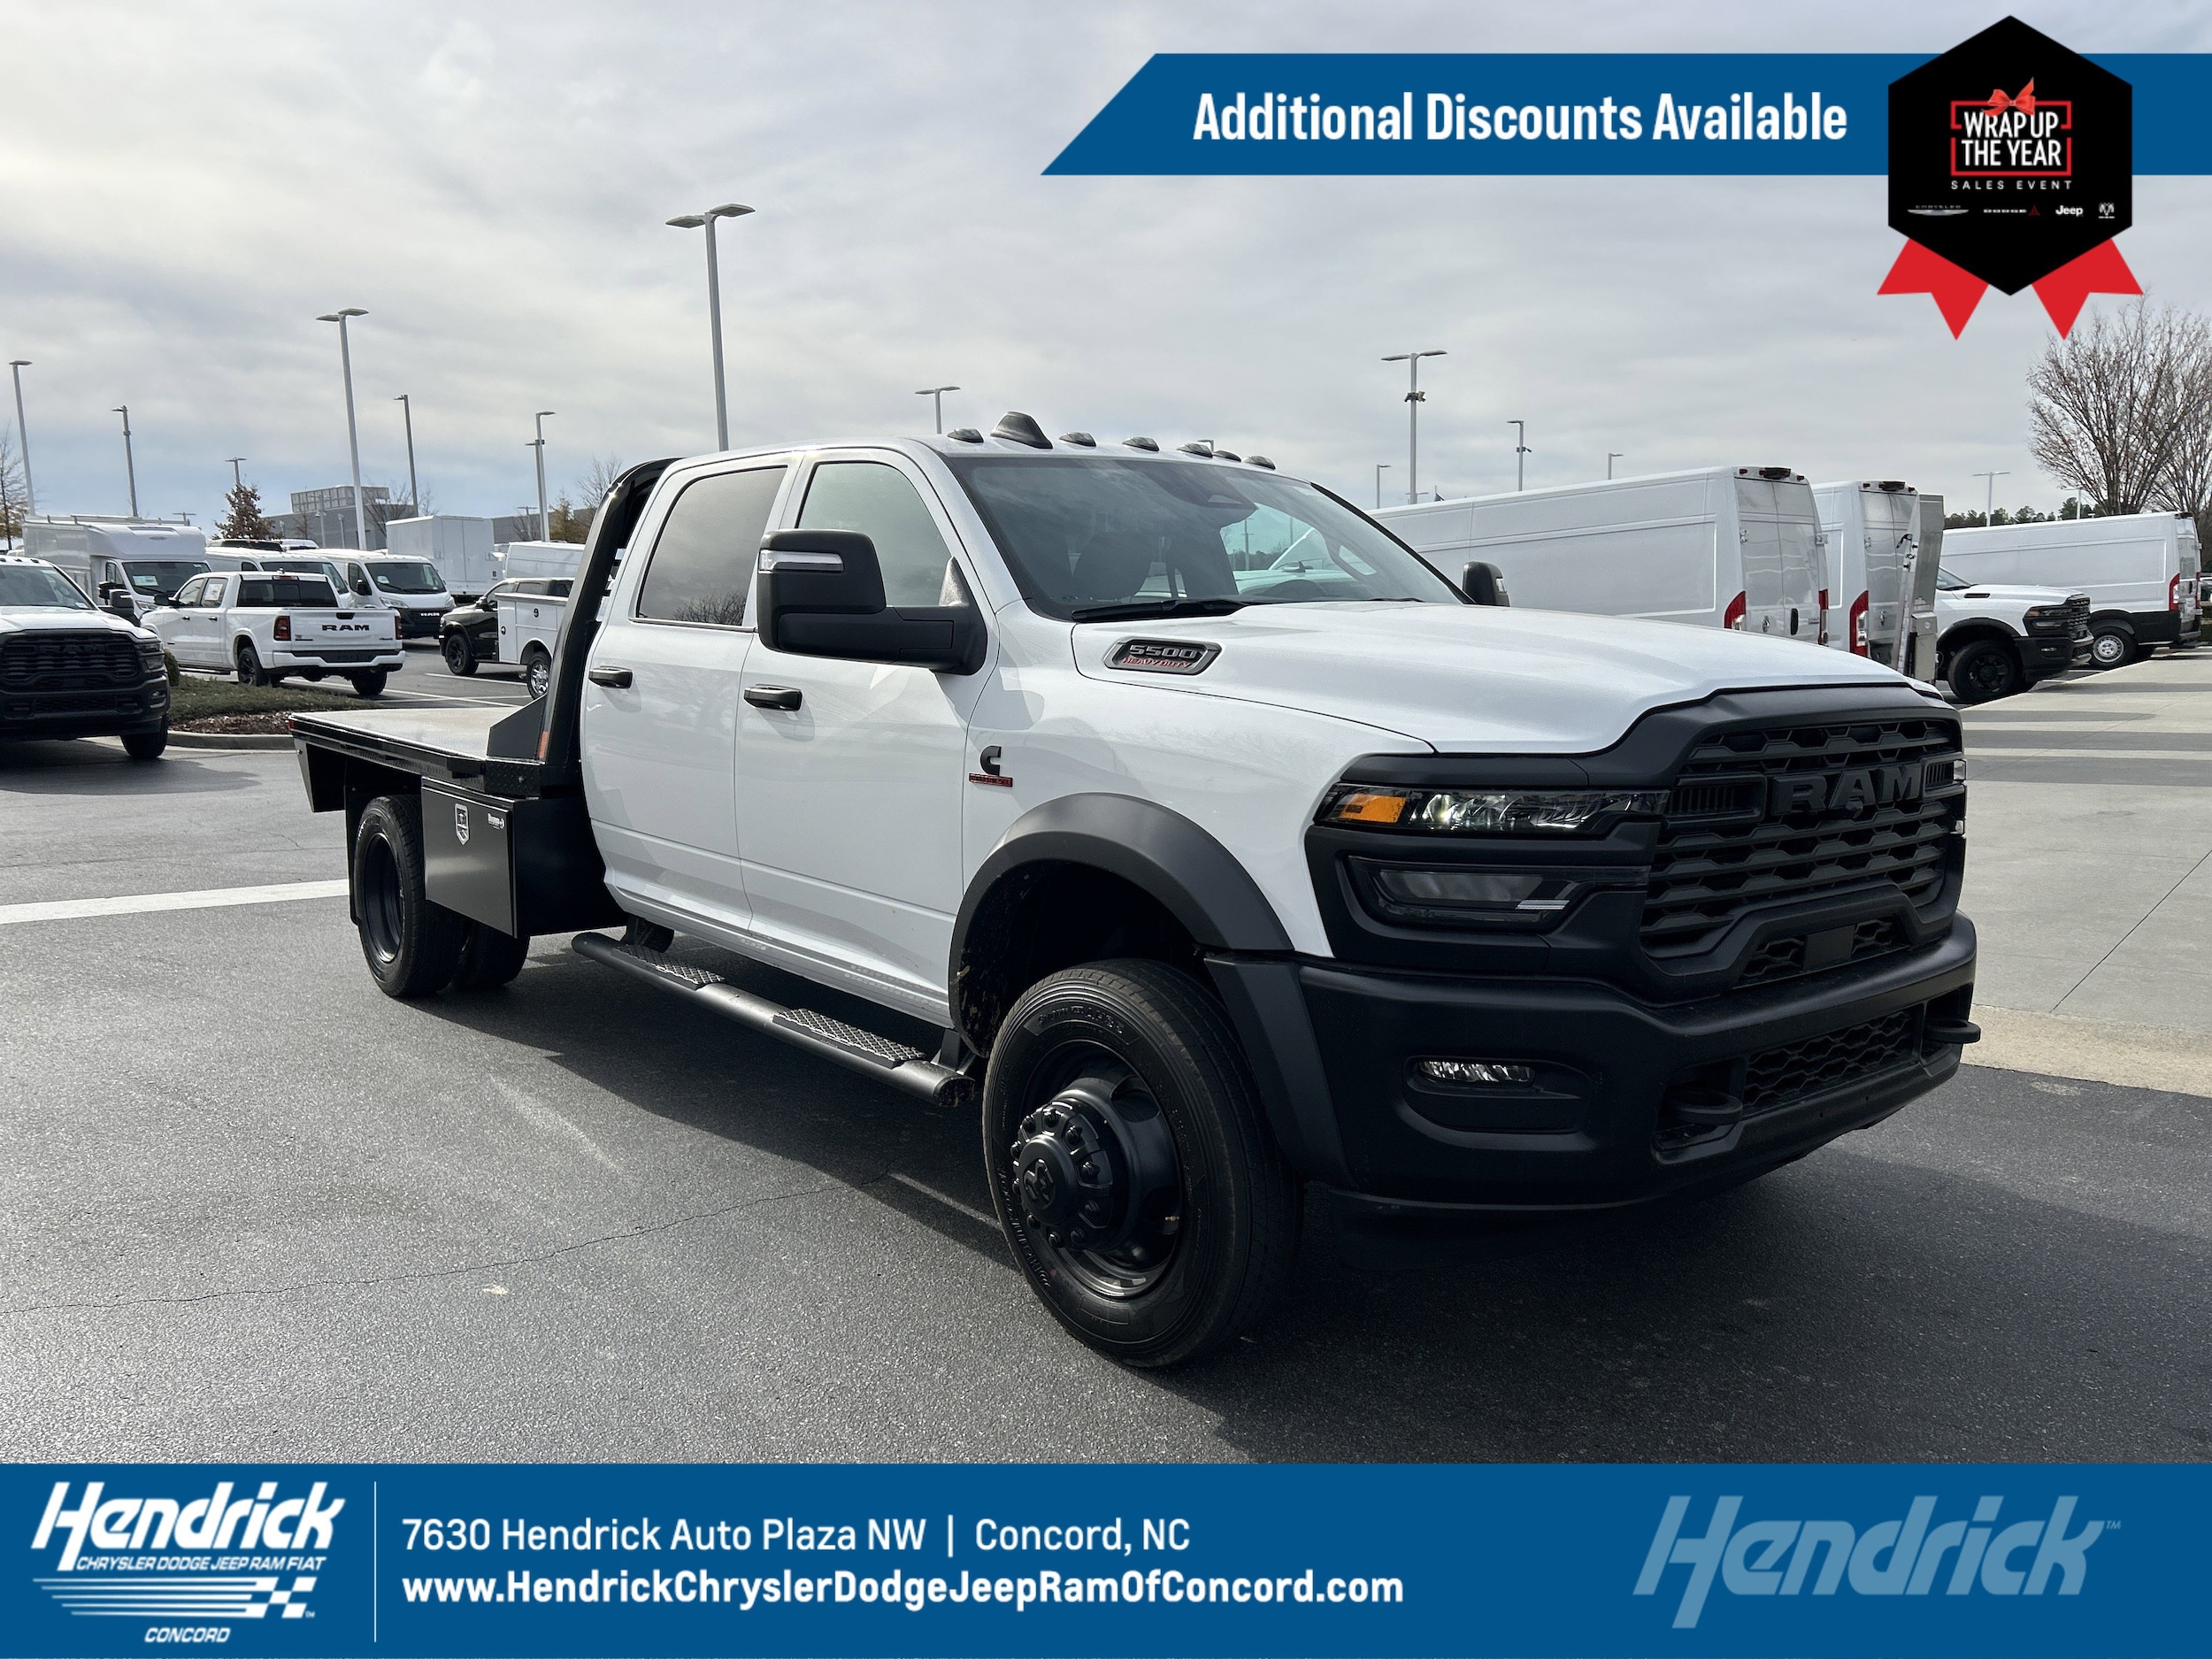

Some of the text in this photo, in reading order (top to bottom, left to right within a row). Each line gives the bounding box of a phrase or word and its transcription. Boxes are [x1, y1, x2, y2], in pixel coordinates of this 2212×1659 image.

[38, 643, 107, 655] RAM
[1129, 644, 1199, 659] 5500
[1121, 657, 1193, 669] HEAVY DUTY
[1770, 762, 1923, 817] RAM
